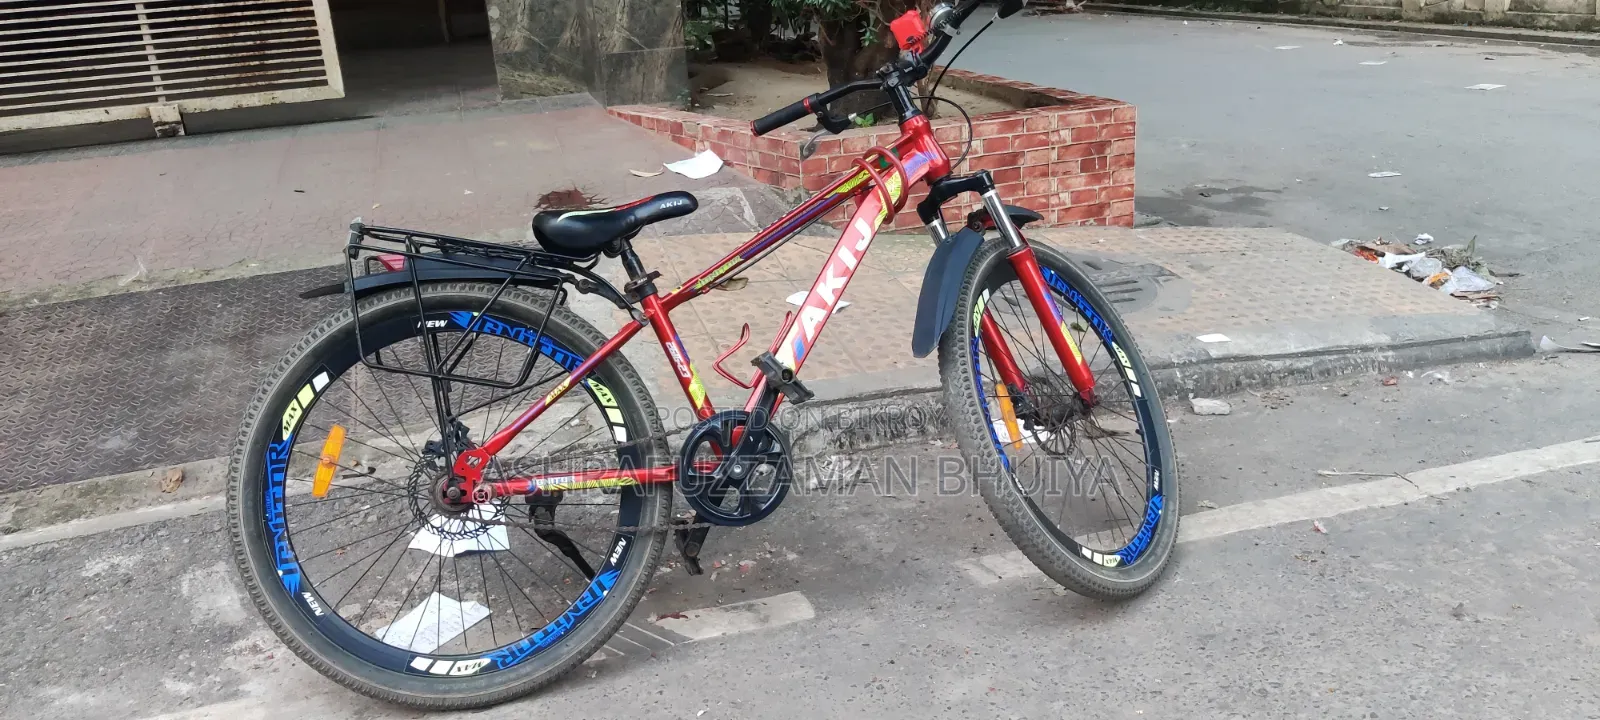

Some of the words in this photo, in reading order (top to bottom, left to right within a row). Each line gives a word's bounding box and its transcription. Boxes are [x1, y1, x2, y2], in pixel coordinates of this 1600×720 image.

[660, 200, 683, 209] AKIJ
[801, 217, 872, 342] AKIJ
[592, 382, 614, 403] MAX
[283, 404, 298, 435] MAX
[609, 537, 627, 567] NEW
[301, 591, 325, 617] NEW
[456, 660, 484, 673] MAX
